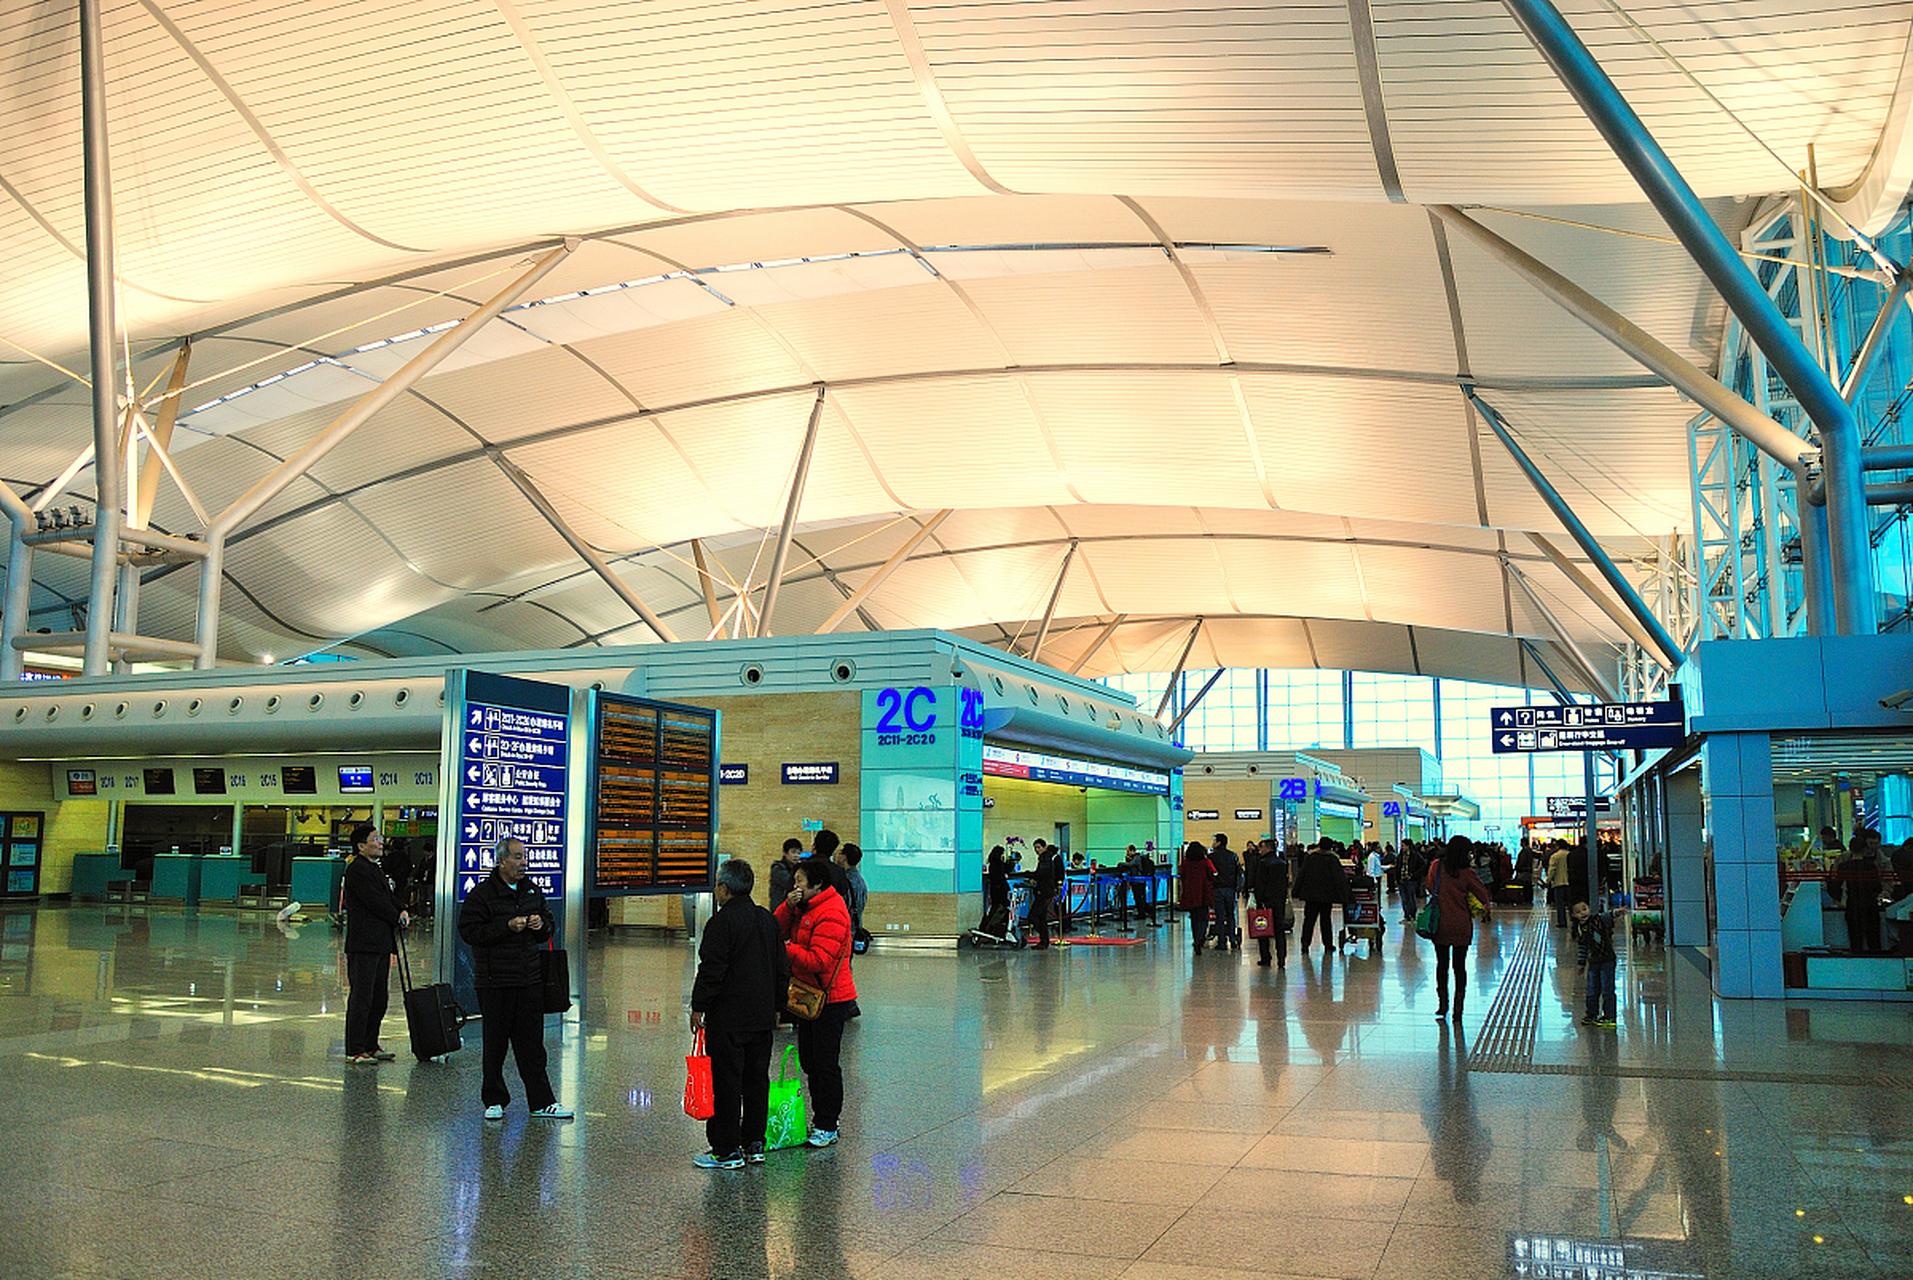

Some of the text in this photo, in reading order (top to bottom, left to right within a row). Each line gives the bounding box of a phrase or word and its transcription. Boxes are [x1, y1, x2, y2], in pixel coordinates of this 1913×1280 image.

[877, 687, 936, 733] 2C
[961, 687, 984, 728] 2C
[878, 734, 936, 745] 2C11-2C20
[260, 774, 277, 787] 2C15
[379, 773, 398, 786] 2C14
[414, 772, 433, 785] 2C13
[1280, 778, 1306, 799] 2B
[1383, 801, 1401, 815] 2A
